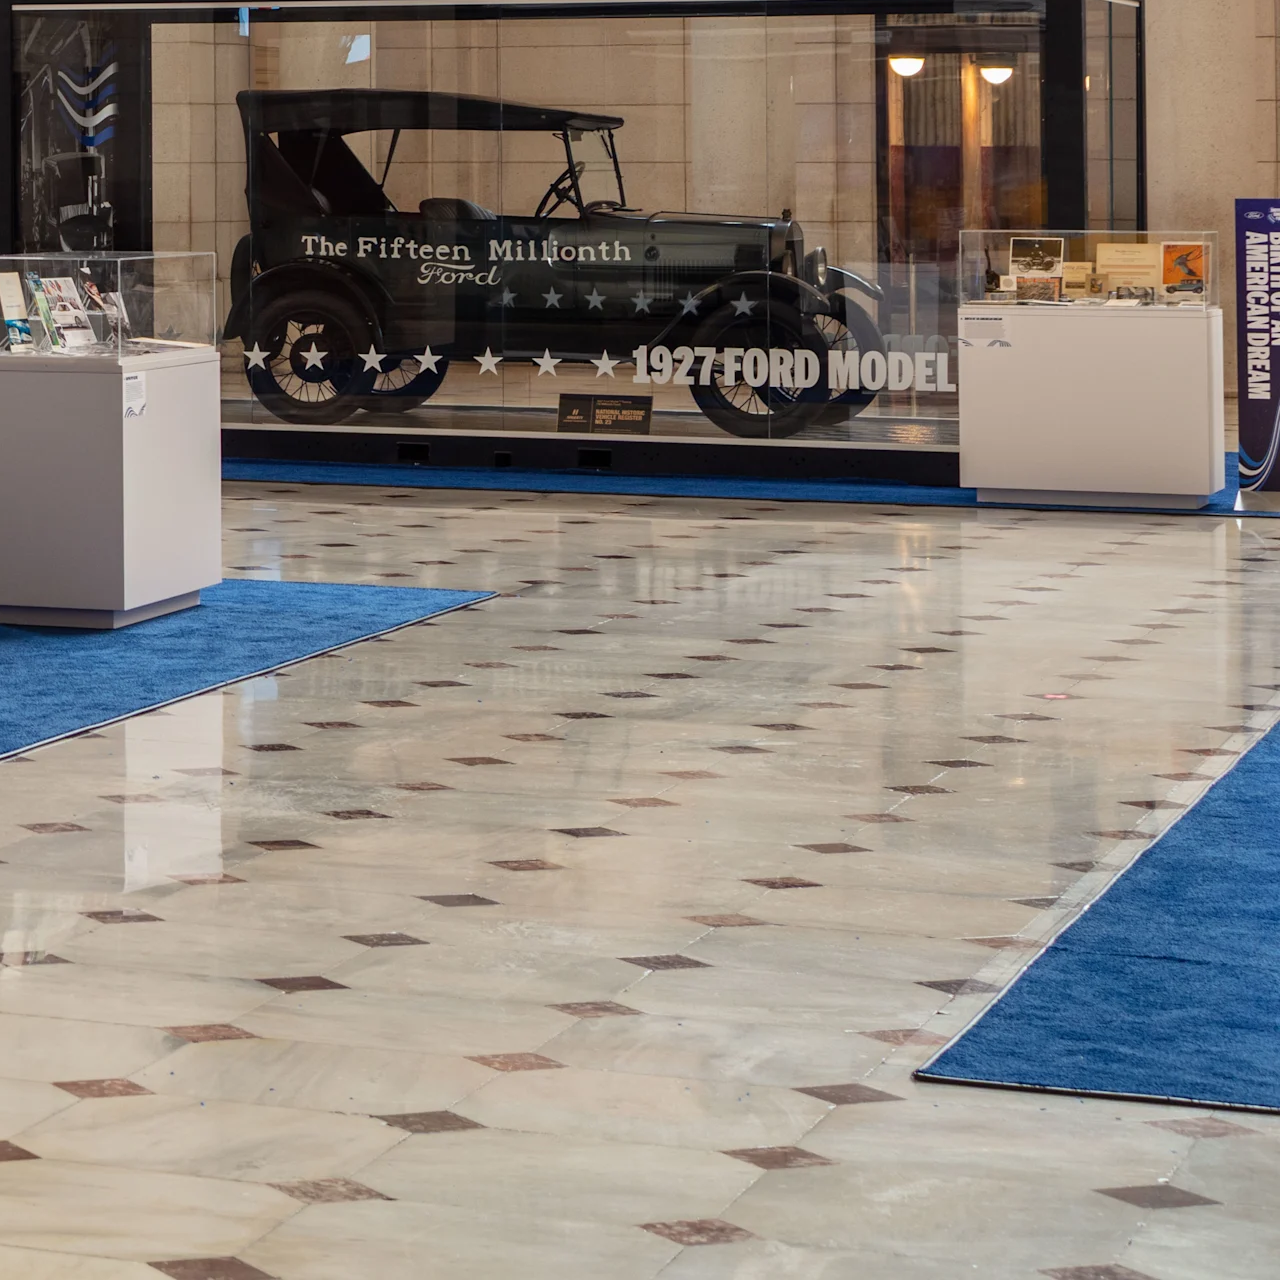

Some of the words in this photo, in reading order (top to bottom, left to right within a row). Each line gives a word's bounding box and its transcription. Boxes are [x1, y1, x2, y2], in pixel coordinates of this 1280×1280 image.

[301, 235, 348, 257] The
[357, 236, 471, 261] Fifteen
[488, 239, 632, 261] Millionth
[416, 262, 501, 285] Ford
[1245, 231, 1269, 329] AMERICAN
[632, 344, 716, 385] 1927
[723, 347, 820, 389] FORD
[827, 350, 957, 392] MODEL
[1247, 333, 1271, 400] DREAM
